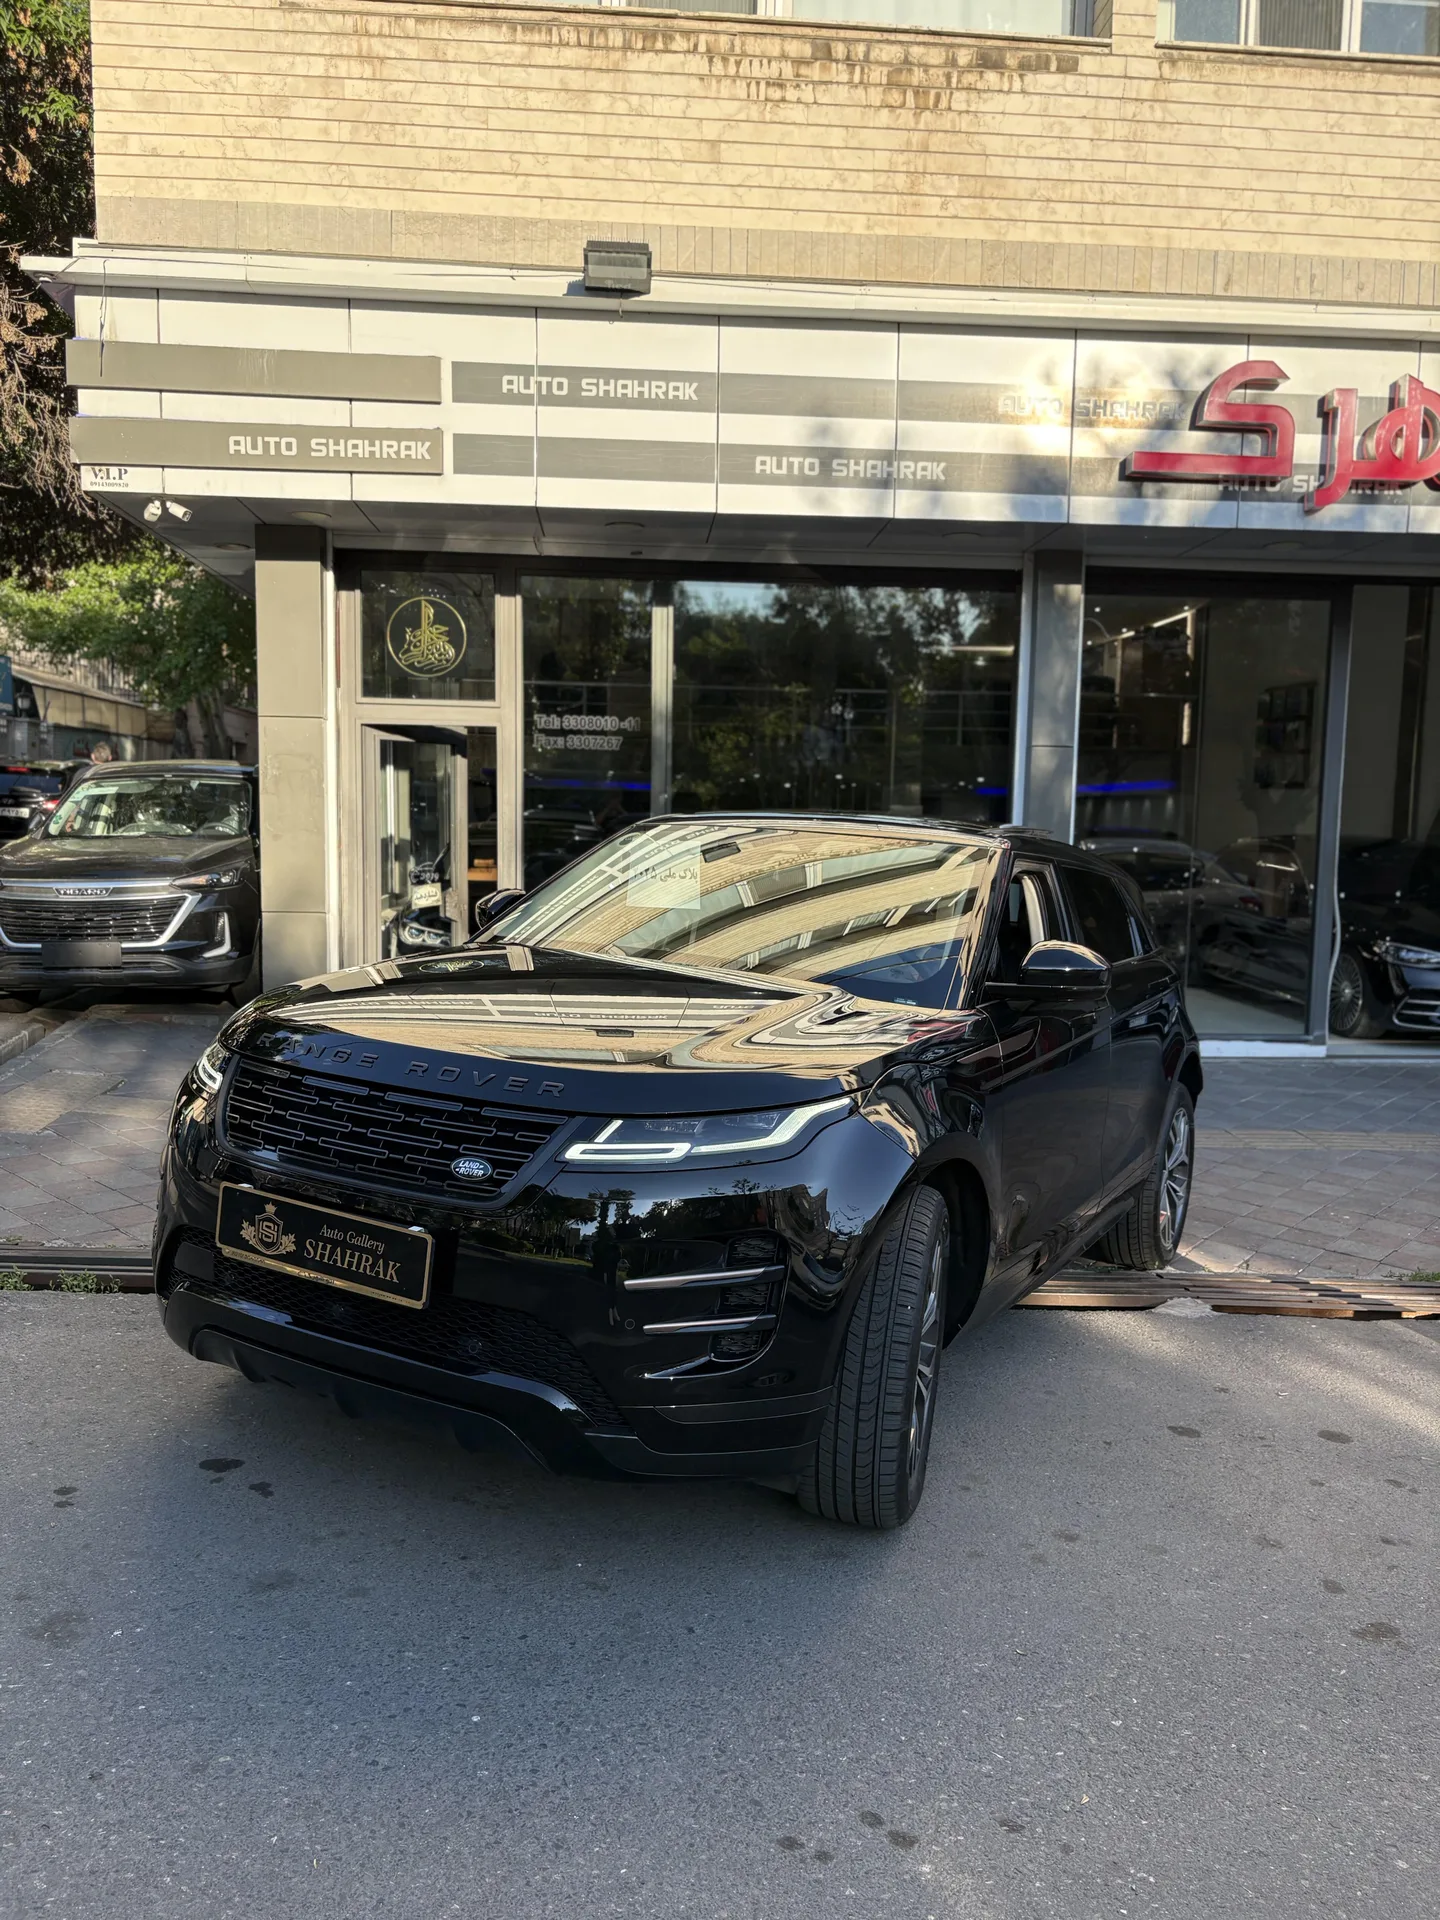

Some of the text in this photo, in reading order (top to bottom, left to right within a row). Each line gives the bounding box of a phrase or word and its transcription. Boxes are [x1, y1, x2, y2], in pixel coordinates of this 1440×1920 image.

[501, 375, 699, 401] AUTO SHAHRAK
[998, 395, 1188, 420] AUTO SHAHRAK
[228, 435, 432, 460] AUTO SHAHRAK
[90, 467, 128, 481] V.I.P
[755, 455, 947, 481] AUTO SHAHRAK
[534, 714, 561, 730] Tel:
[562, 715, 619, 731] 3308010
[532, 734, 623, 751] Fax: 3307267
[659, 867, 677, 882] ملی
[679, 867, 699, 884] پلاک
[256, 1032, 565, 1098] RANGE ROVER
[458, 1168, 484, 1177] ROVER
[459, 1160, 480, 1169] LAND
[319, 1224, 385, 1255] Auto Gallery
[303, 1238, 402, 1284] SHAHRAK
